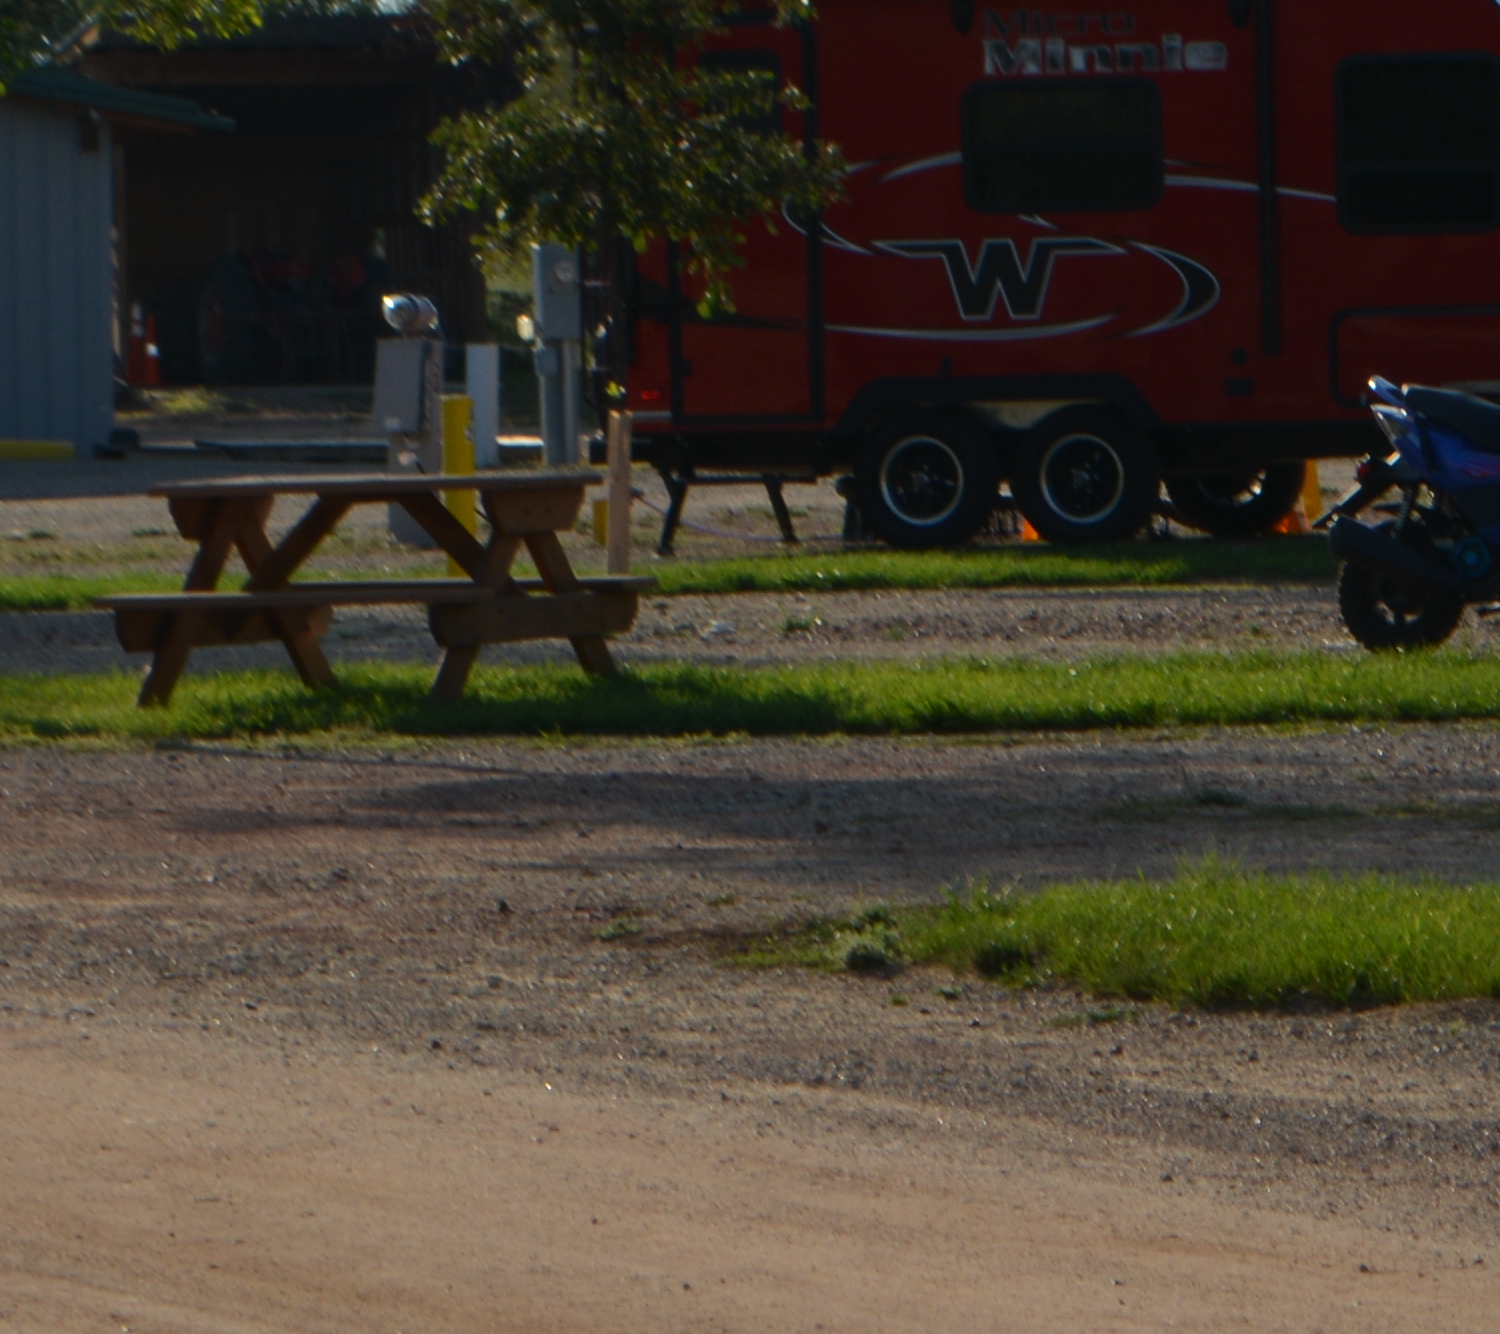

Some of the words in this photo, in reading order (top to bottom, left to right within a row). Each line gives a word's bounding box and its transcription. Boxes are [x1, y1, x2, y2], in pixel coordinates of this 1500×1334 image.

[983, 8, 1136, 35] Micro
[982, 33, 1228, 77] Minnie
[870, 236, 1130, 321] W
